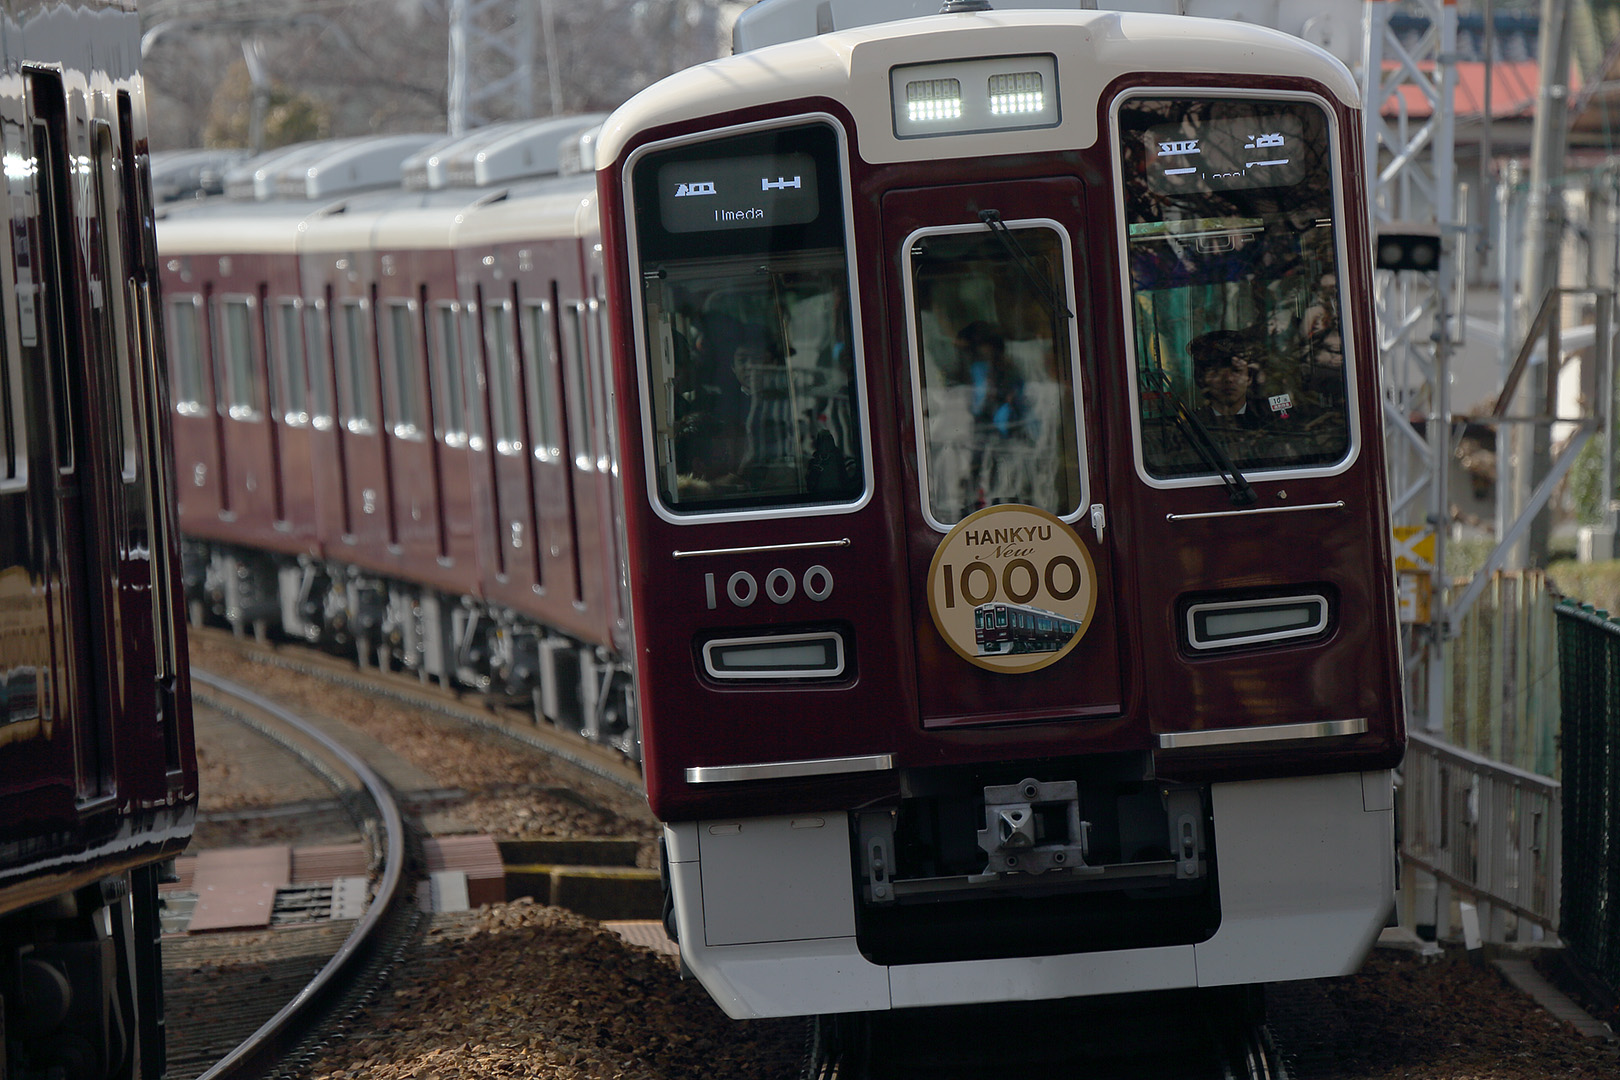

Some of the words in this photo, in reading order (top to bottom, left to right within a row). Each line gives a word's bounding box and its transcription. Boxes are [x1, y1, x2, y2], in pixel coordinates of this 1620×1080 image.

[965, 525, 1052, 546] HANKYU
[975, 543, 1036, 560] New
[704, 564, 834, 610] 1000
[943, 555, 1082, 608] 1000
